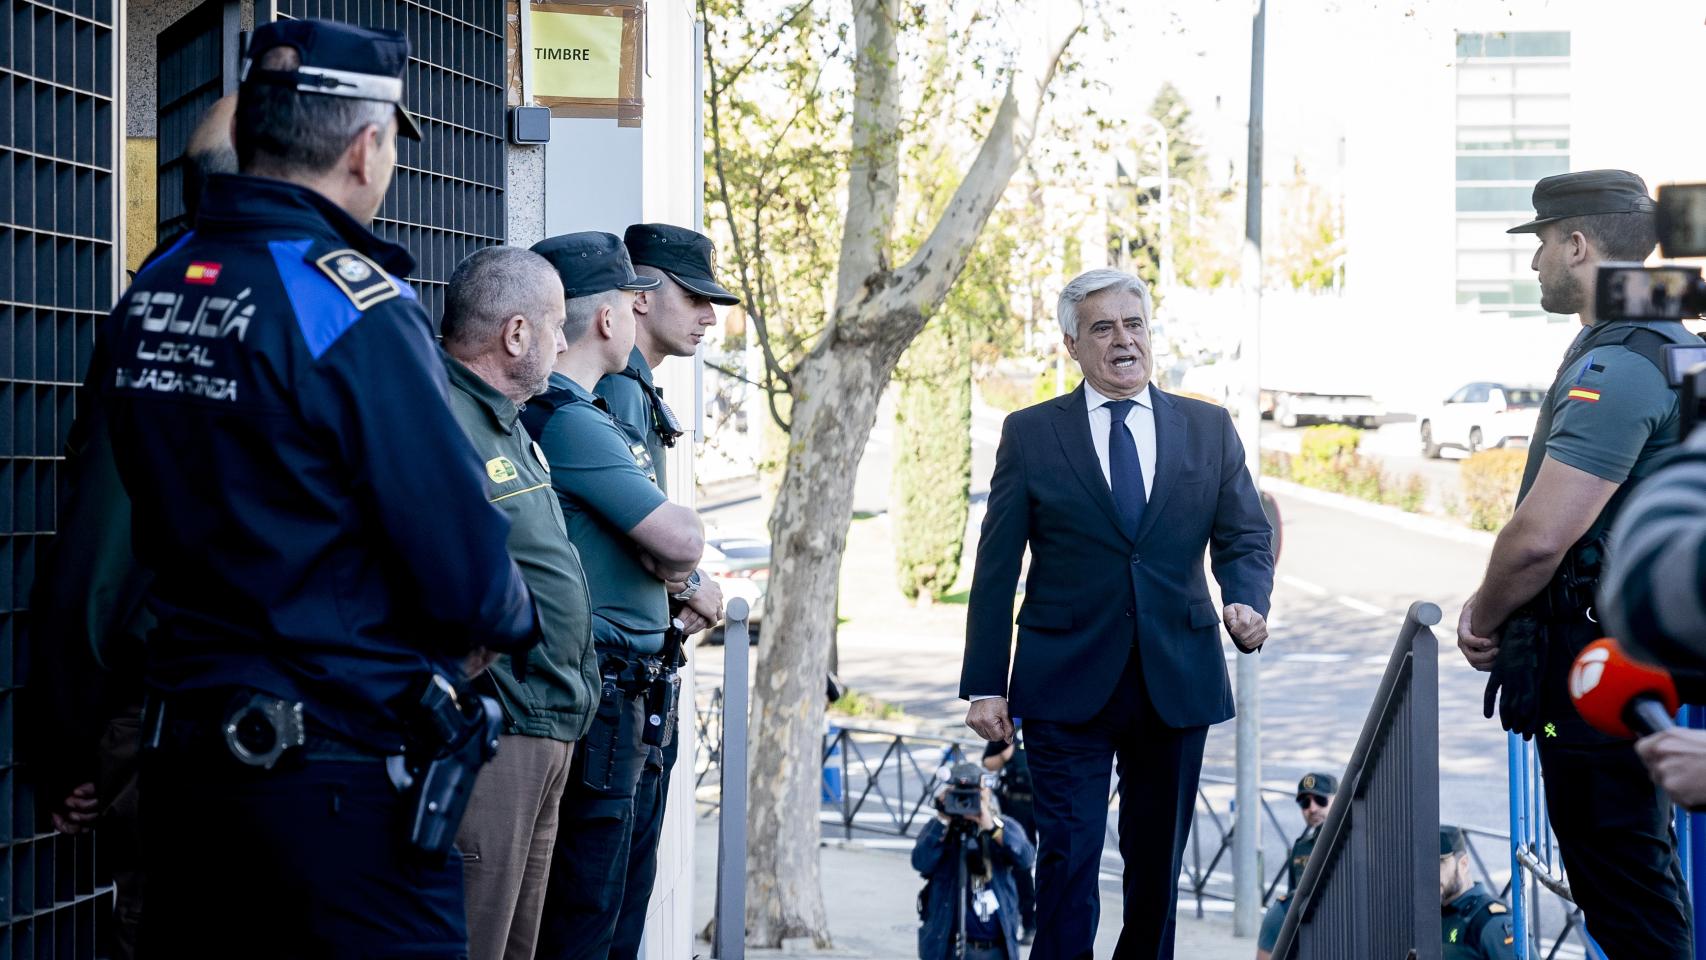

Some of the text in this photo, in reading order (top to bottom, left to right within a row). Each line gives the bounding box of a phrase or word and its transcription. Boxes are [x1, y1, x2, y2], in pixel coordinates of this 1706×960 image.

[534, 47, 590, 61] TIMBRE
[125, 286, 256, 342] POLICÍA
[136, 339, 215, 368] LOCAL
